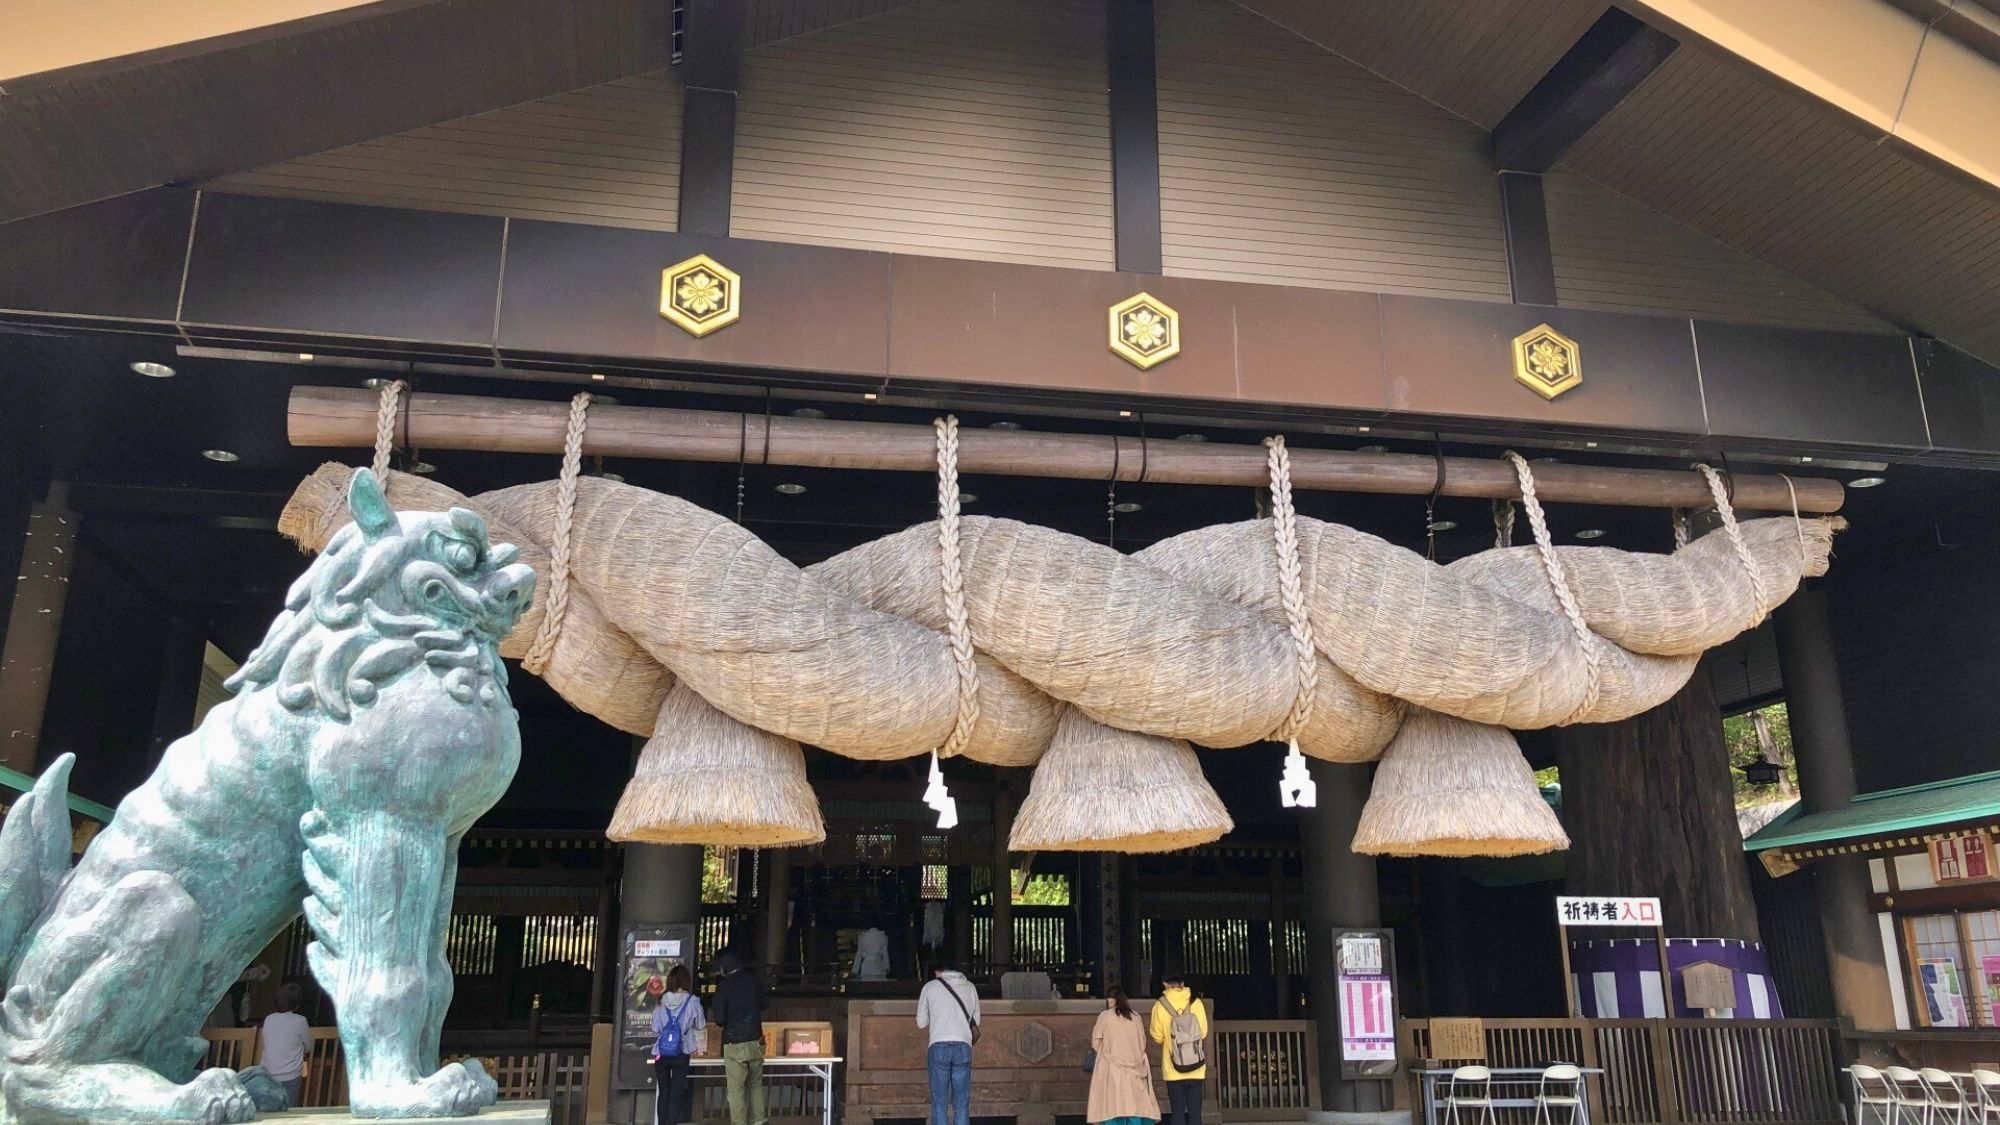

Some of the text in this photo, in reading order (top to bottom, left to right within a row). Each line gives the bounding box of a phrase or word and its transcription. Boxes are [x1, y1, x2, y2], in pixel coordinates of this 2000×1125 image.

[1563, 901, 1655, 921] 祈祷者入口
